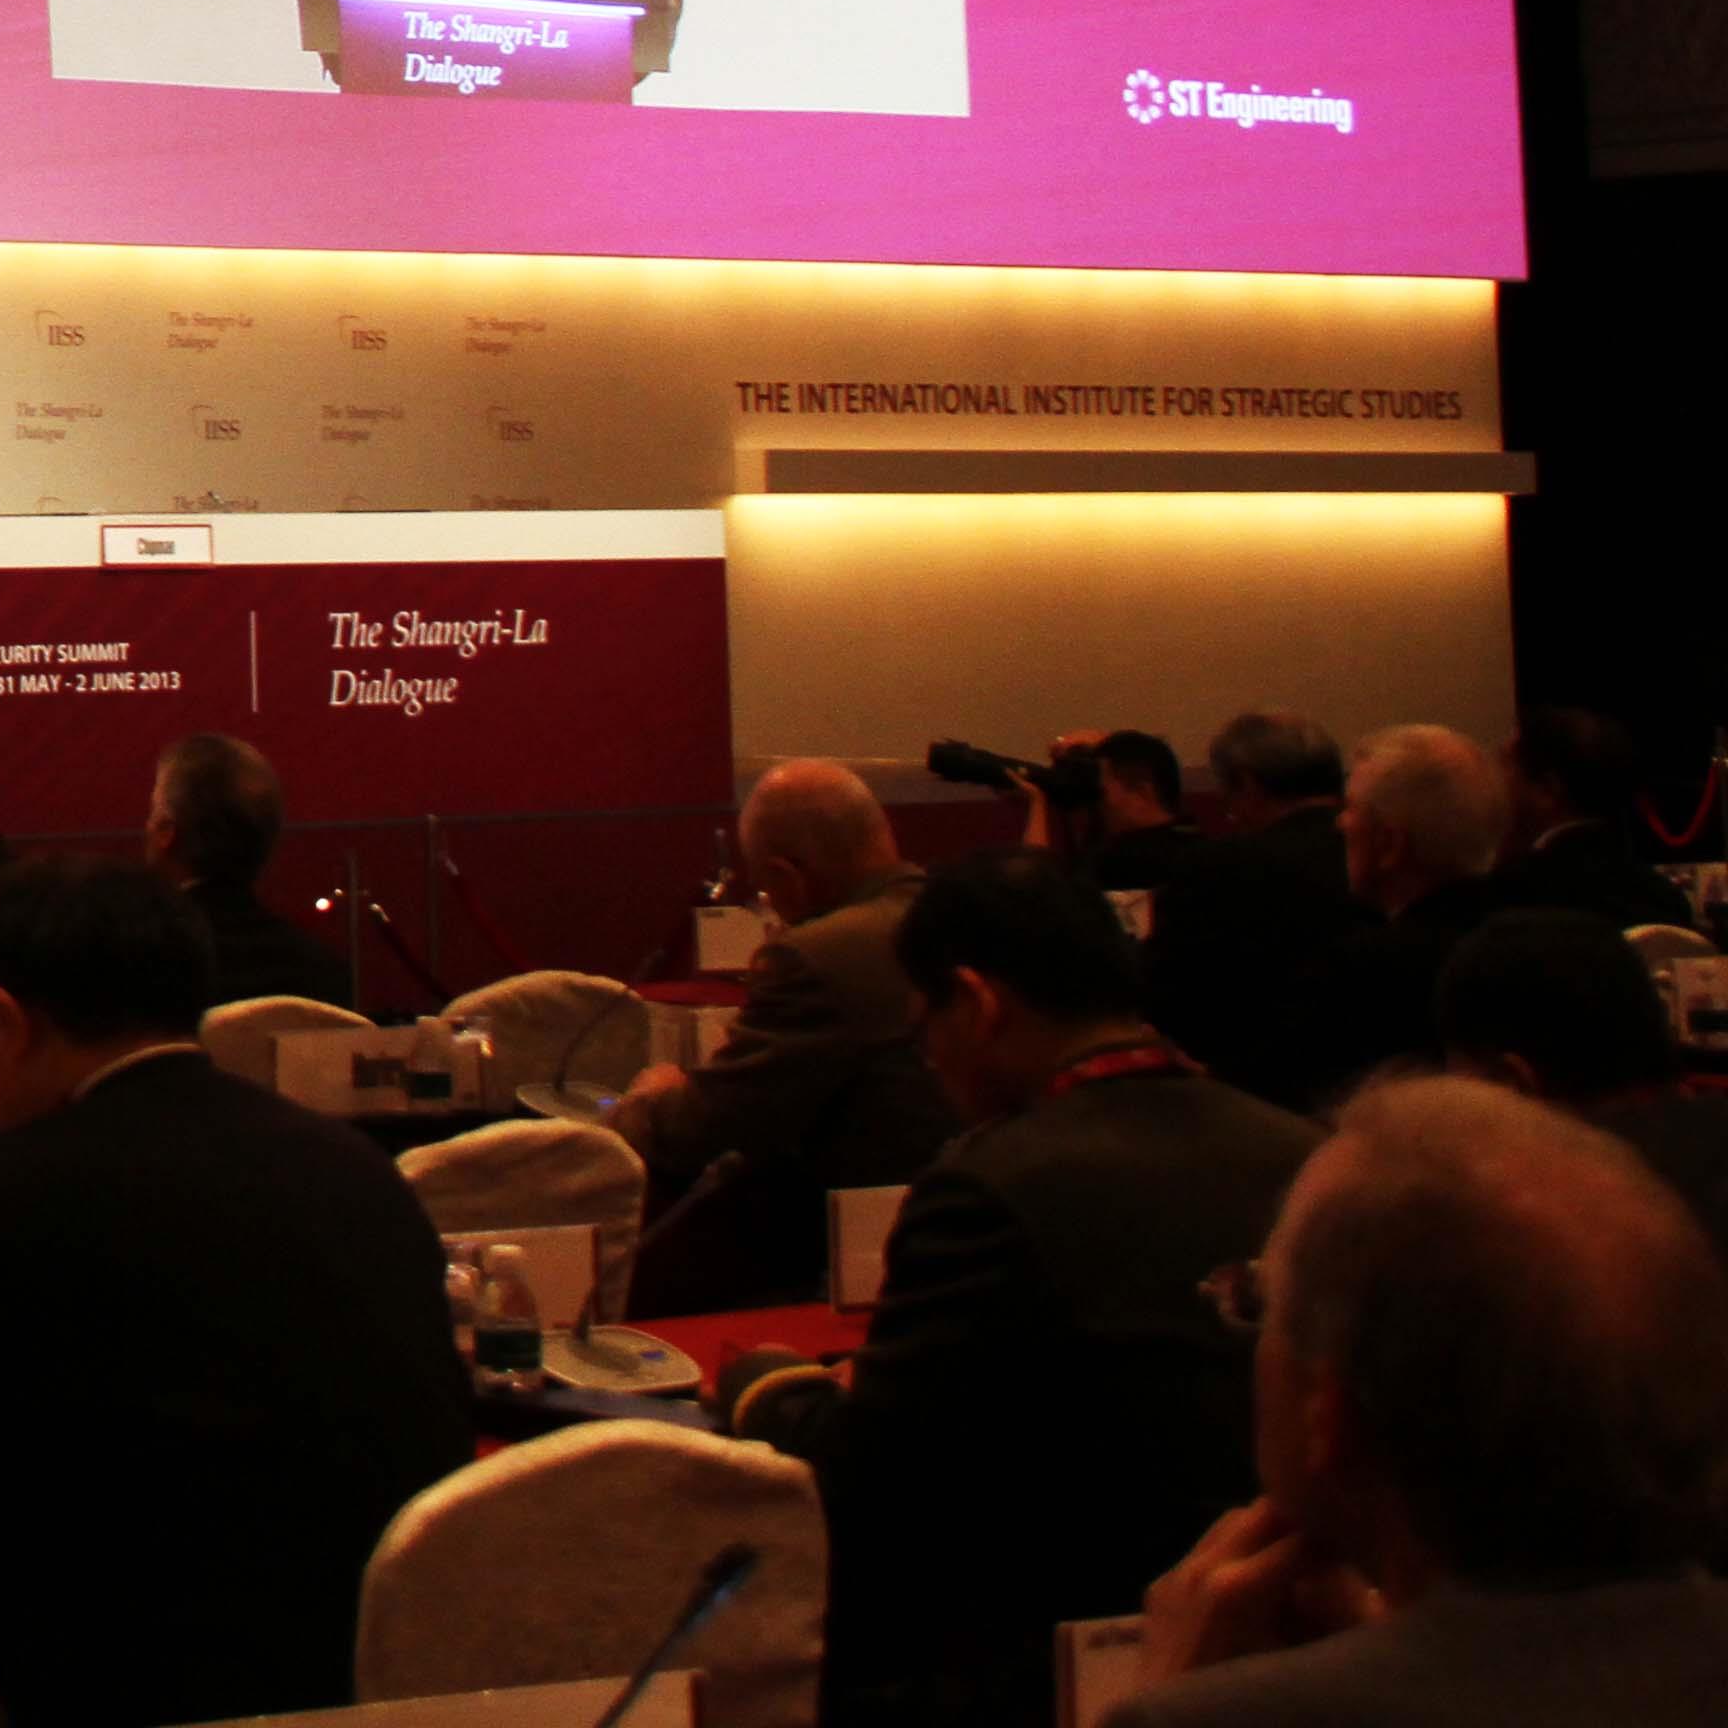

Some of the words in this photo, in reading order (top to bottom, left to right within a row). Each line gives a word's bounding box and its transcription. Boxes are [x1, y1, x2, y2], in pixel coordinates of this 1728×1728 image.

[403, 11, 448, 43] The
[450, 14, 570, 57] Shangri-La
[403, 53, 504, 97] Dialogue
[1168, 78, 1204, 118] ST
[1206, 80, 1354, 134] Engineering
[48, 325, 85, 347] IISS
[736, 381, 791, 414] THE
[797, 382, 1018, 415] INTERNATIONAL
[1023, 384, 1155, 416] INSTITUTE
[1162, 386, 1215, 417] FOR
[1220, 387, 1354, 419] STRATEGIC
[1360, 389, 1463, 421] STUDIES
[57, 643, 129, 663] SUMMIT
[328, 612, 383, 648] The
[392, 609, 548, 658] Shangri-La
[20, 675, 60, 694] MAY
[75, 674, 86, 692] 2
[90, 673, 135, 692] JUNE
[139, 671, 181, 690] 2013
[329, 668, 458, 716] Dialogue
